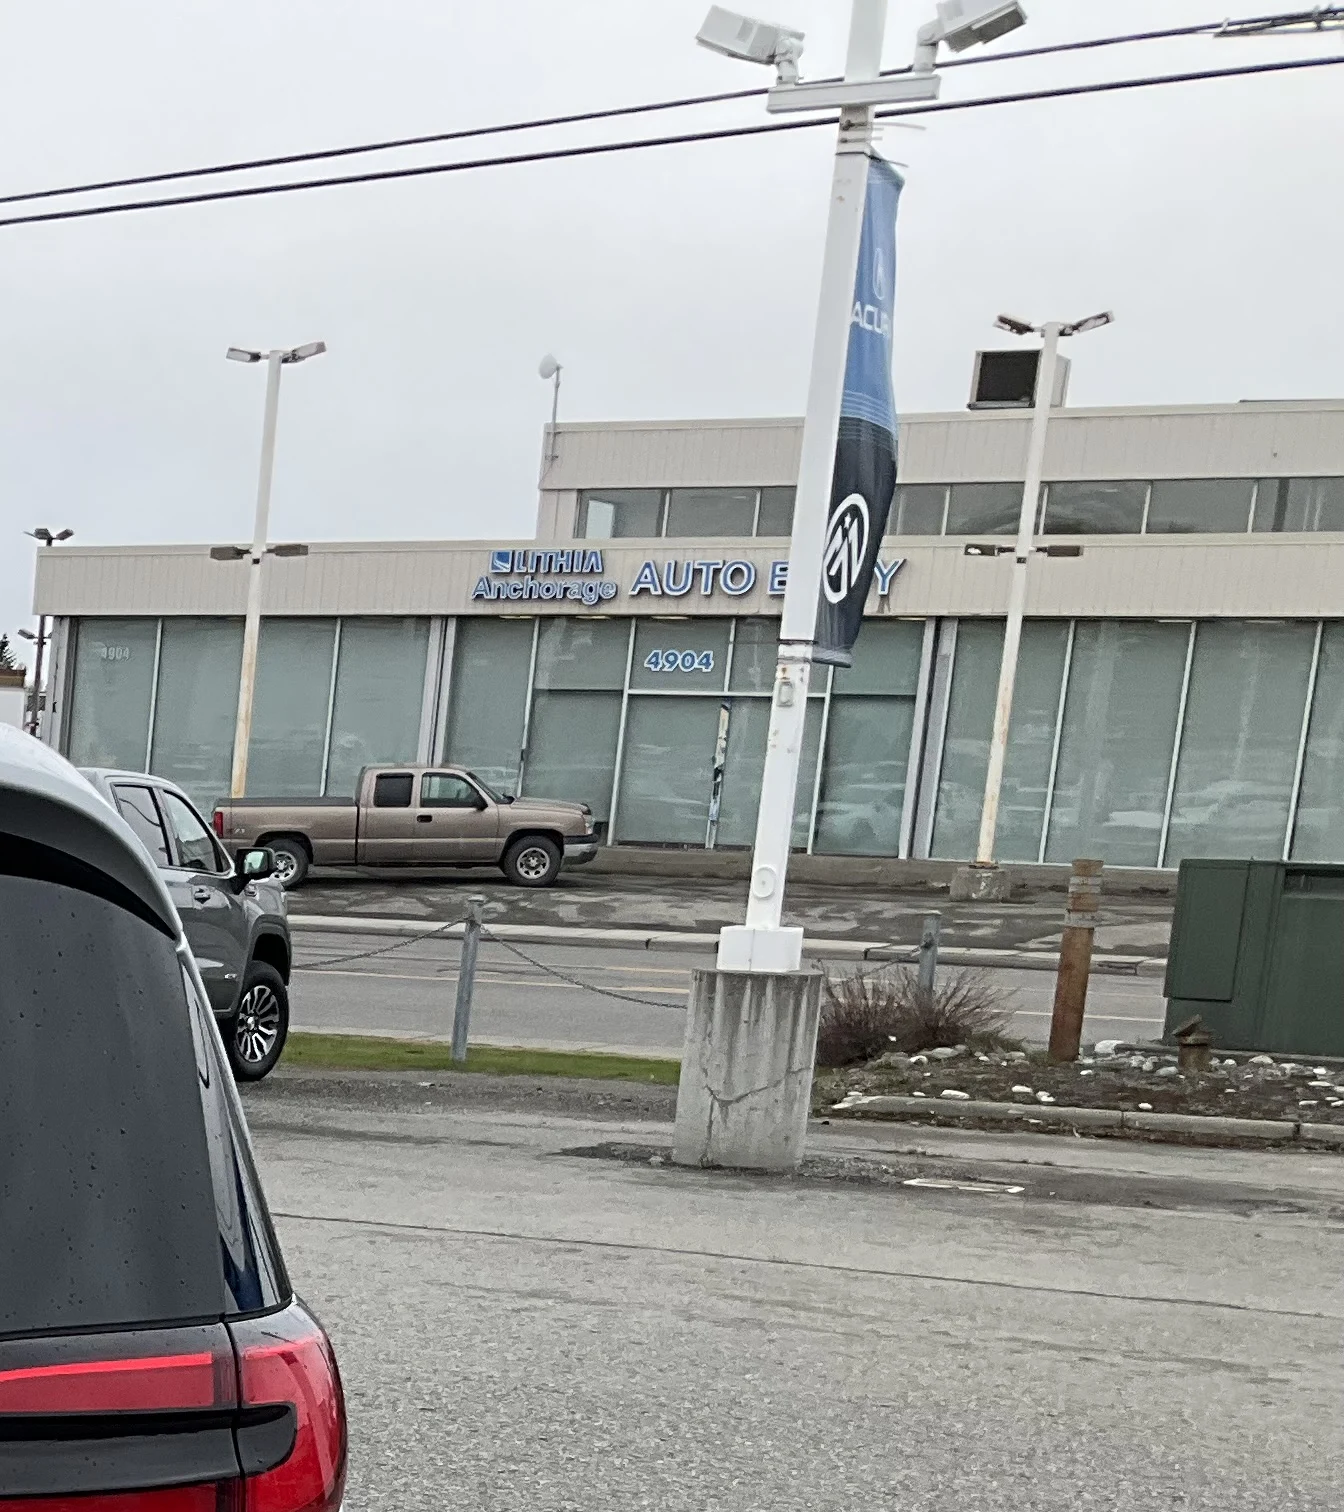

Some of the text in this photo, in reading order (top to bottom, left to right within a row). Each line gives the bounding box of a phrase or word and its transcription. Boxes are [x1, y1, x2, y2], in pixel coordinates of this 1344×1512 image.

[513, 549, 604, 574] LITHIA
[629, 557, 907, 597] AUTO BY
[472, 576, 618, 606] Anchorage
[644, 649, 714, 673] 4904
